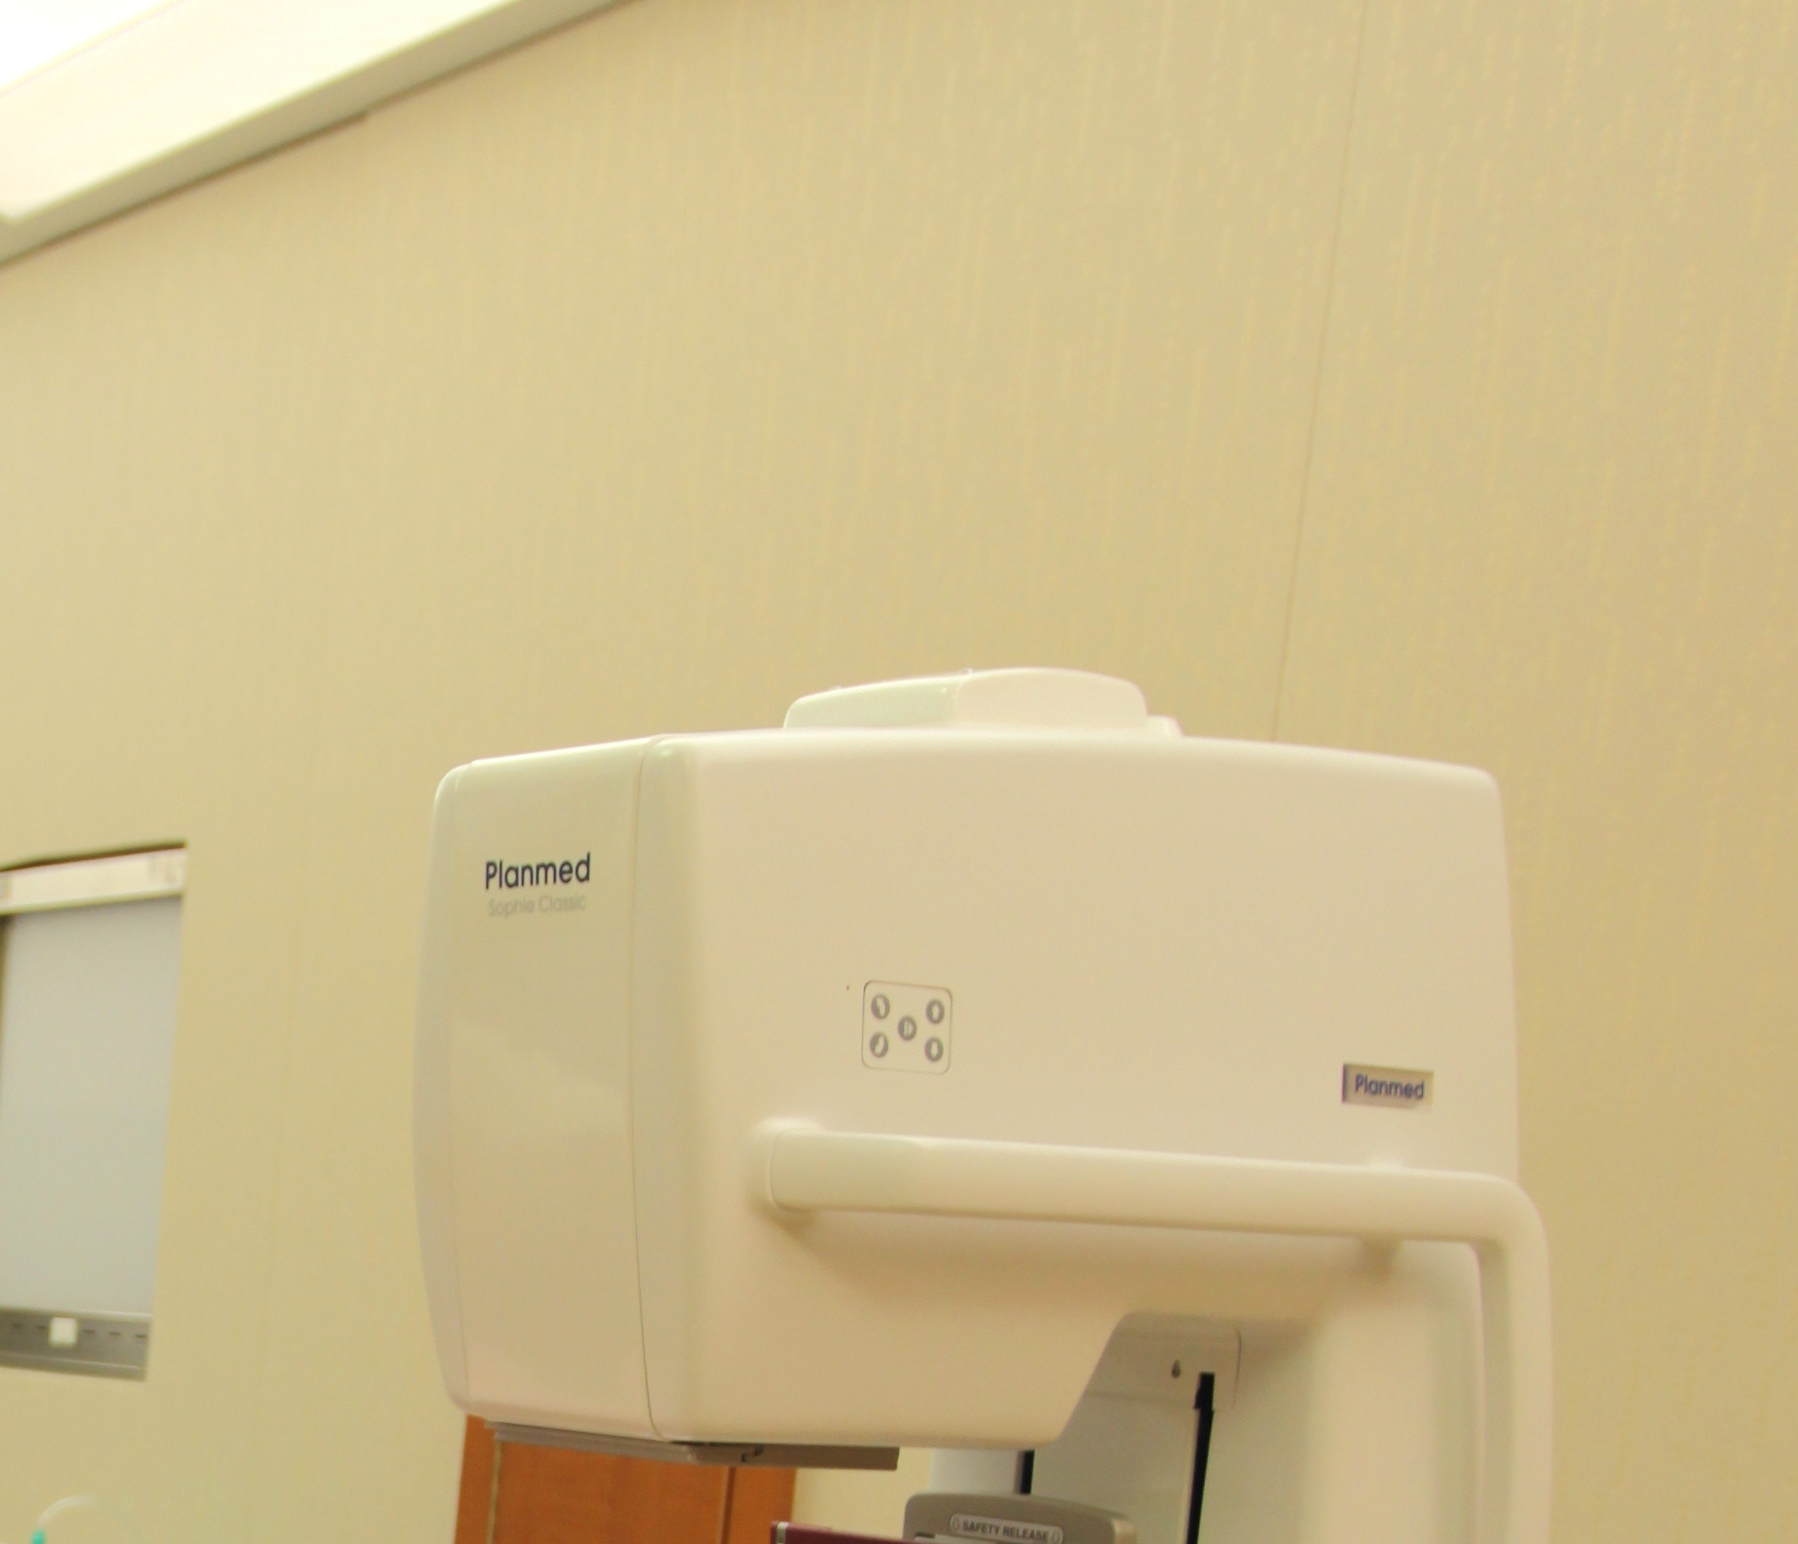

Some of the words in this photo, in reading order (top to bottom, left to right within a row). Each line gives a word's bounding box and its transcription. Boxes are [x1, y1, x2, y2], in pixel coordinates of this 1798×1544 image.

[485, 852, 591, 891] Planmed
[538, 893, 587, 913] Classic
[1354, 1073, 1425, 1099] Planmed
[963, 1519, 1001, 1535] SAFETY
[1003, 1525, 1049, 1541] RELEASE
